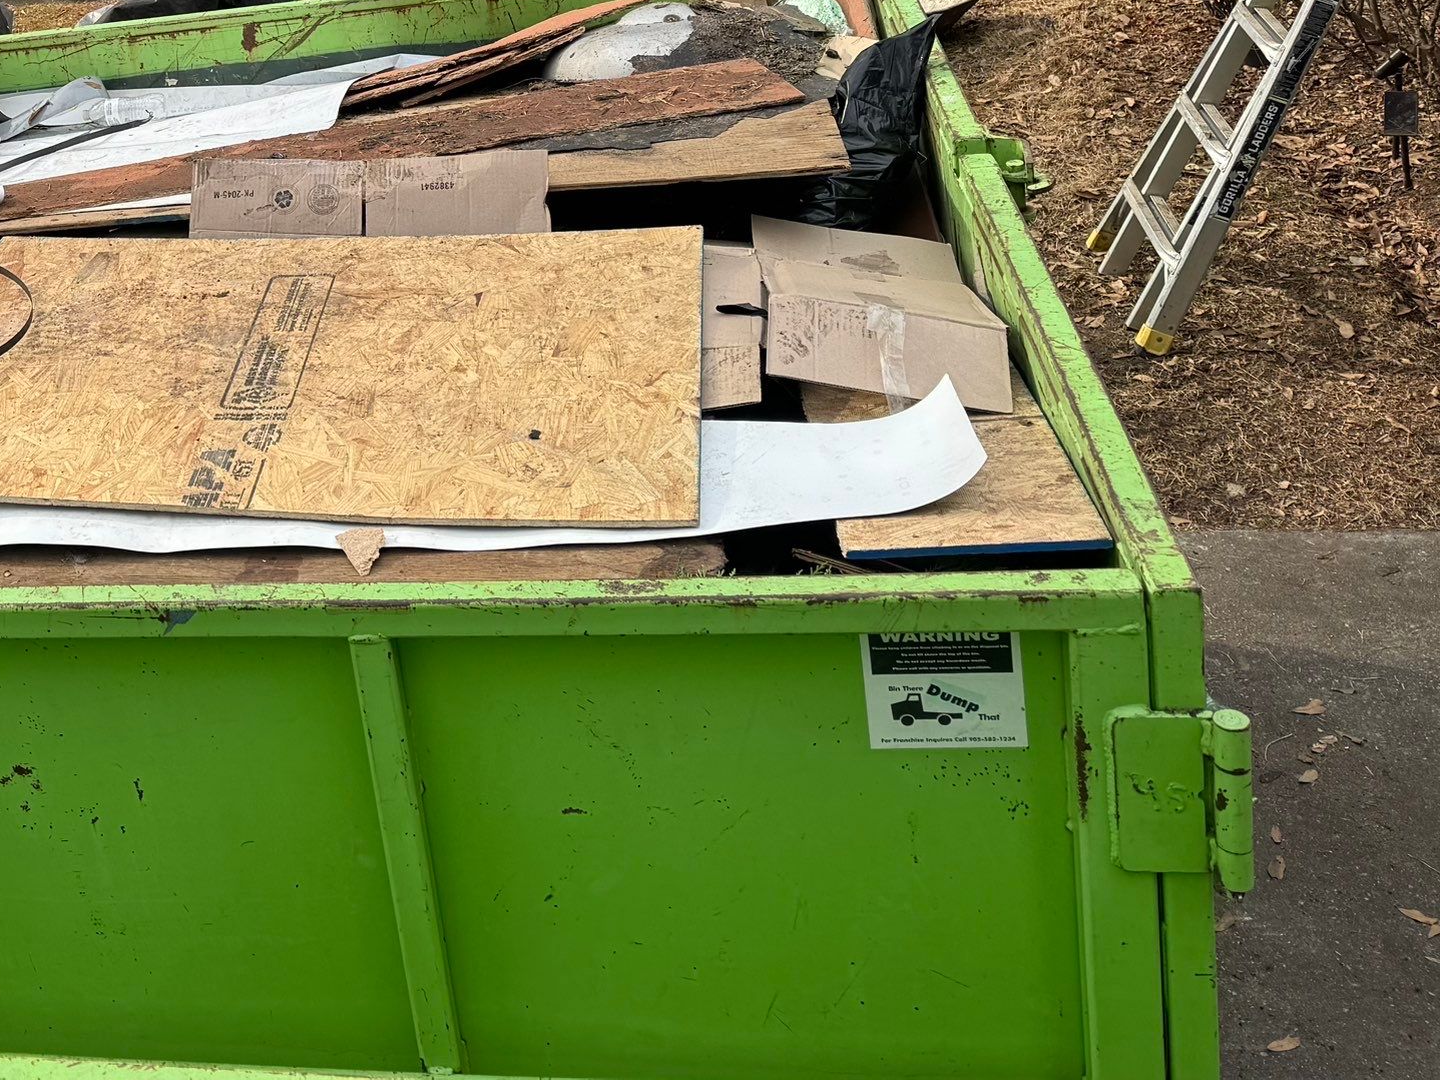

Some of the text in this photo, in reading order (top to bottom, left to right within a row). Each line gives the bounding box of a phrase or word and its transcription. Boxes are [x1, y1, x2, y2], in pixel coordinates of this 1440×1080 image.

[1218, 104, 1279, 214] GORILLA LADDERS
[880, 632, 1000, 643] WARNING
[926, 683, 980, 714] Dump
[978, 713, 1000, 721] That
